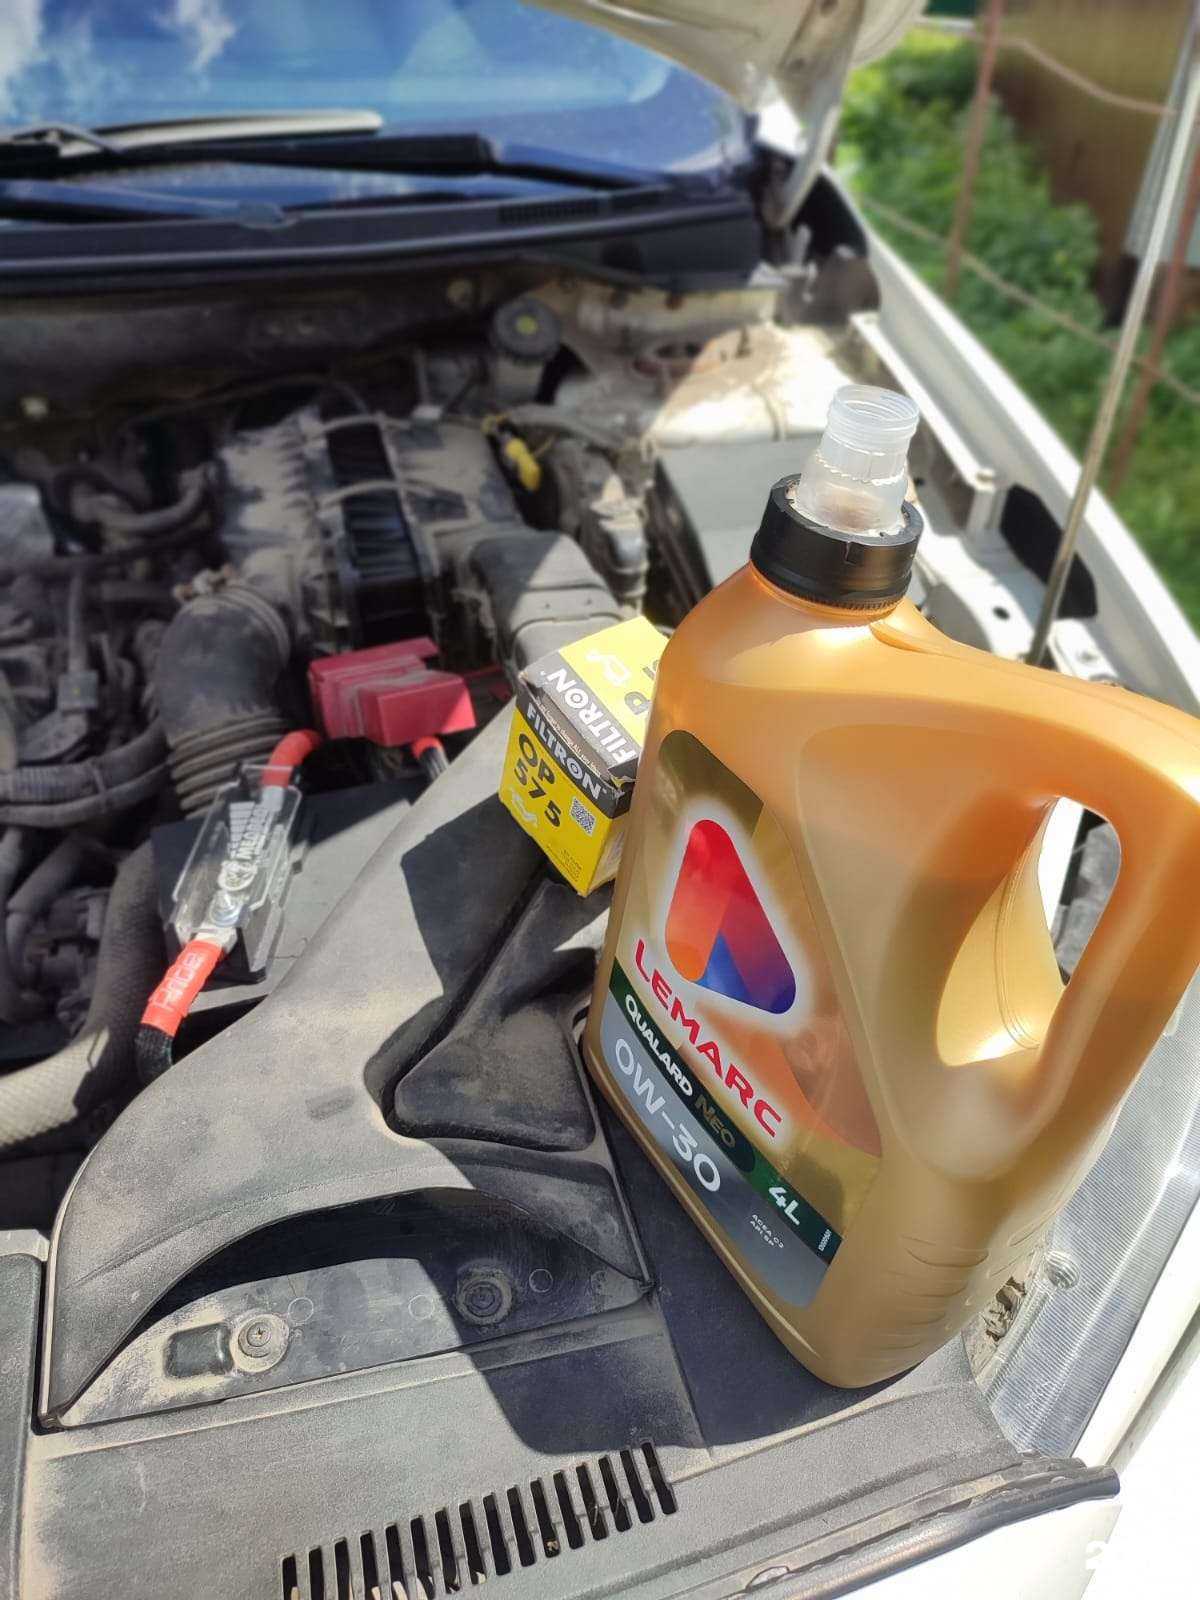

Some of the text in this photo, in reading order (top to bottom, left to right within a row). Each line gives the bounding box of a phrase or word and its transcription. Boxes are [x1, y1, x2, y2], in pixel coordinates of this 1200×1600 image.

[518, 734, 555, 786] OP
[527, 703, 602, 800] FILTRON
[547, 668, 637, 764] FILTRON
[514, 758, 561, 827] 575
[625, 994, 736, 1149] QUALARD NEO
[635, 938, 783, 1138] LEMARC
[615, 1038, 721, 1192] 0W-30
[768, 1185, 800, 1225] 4L
